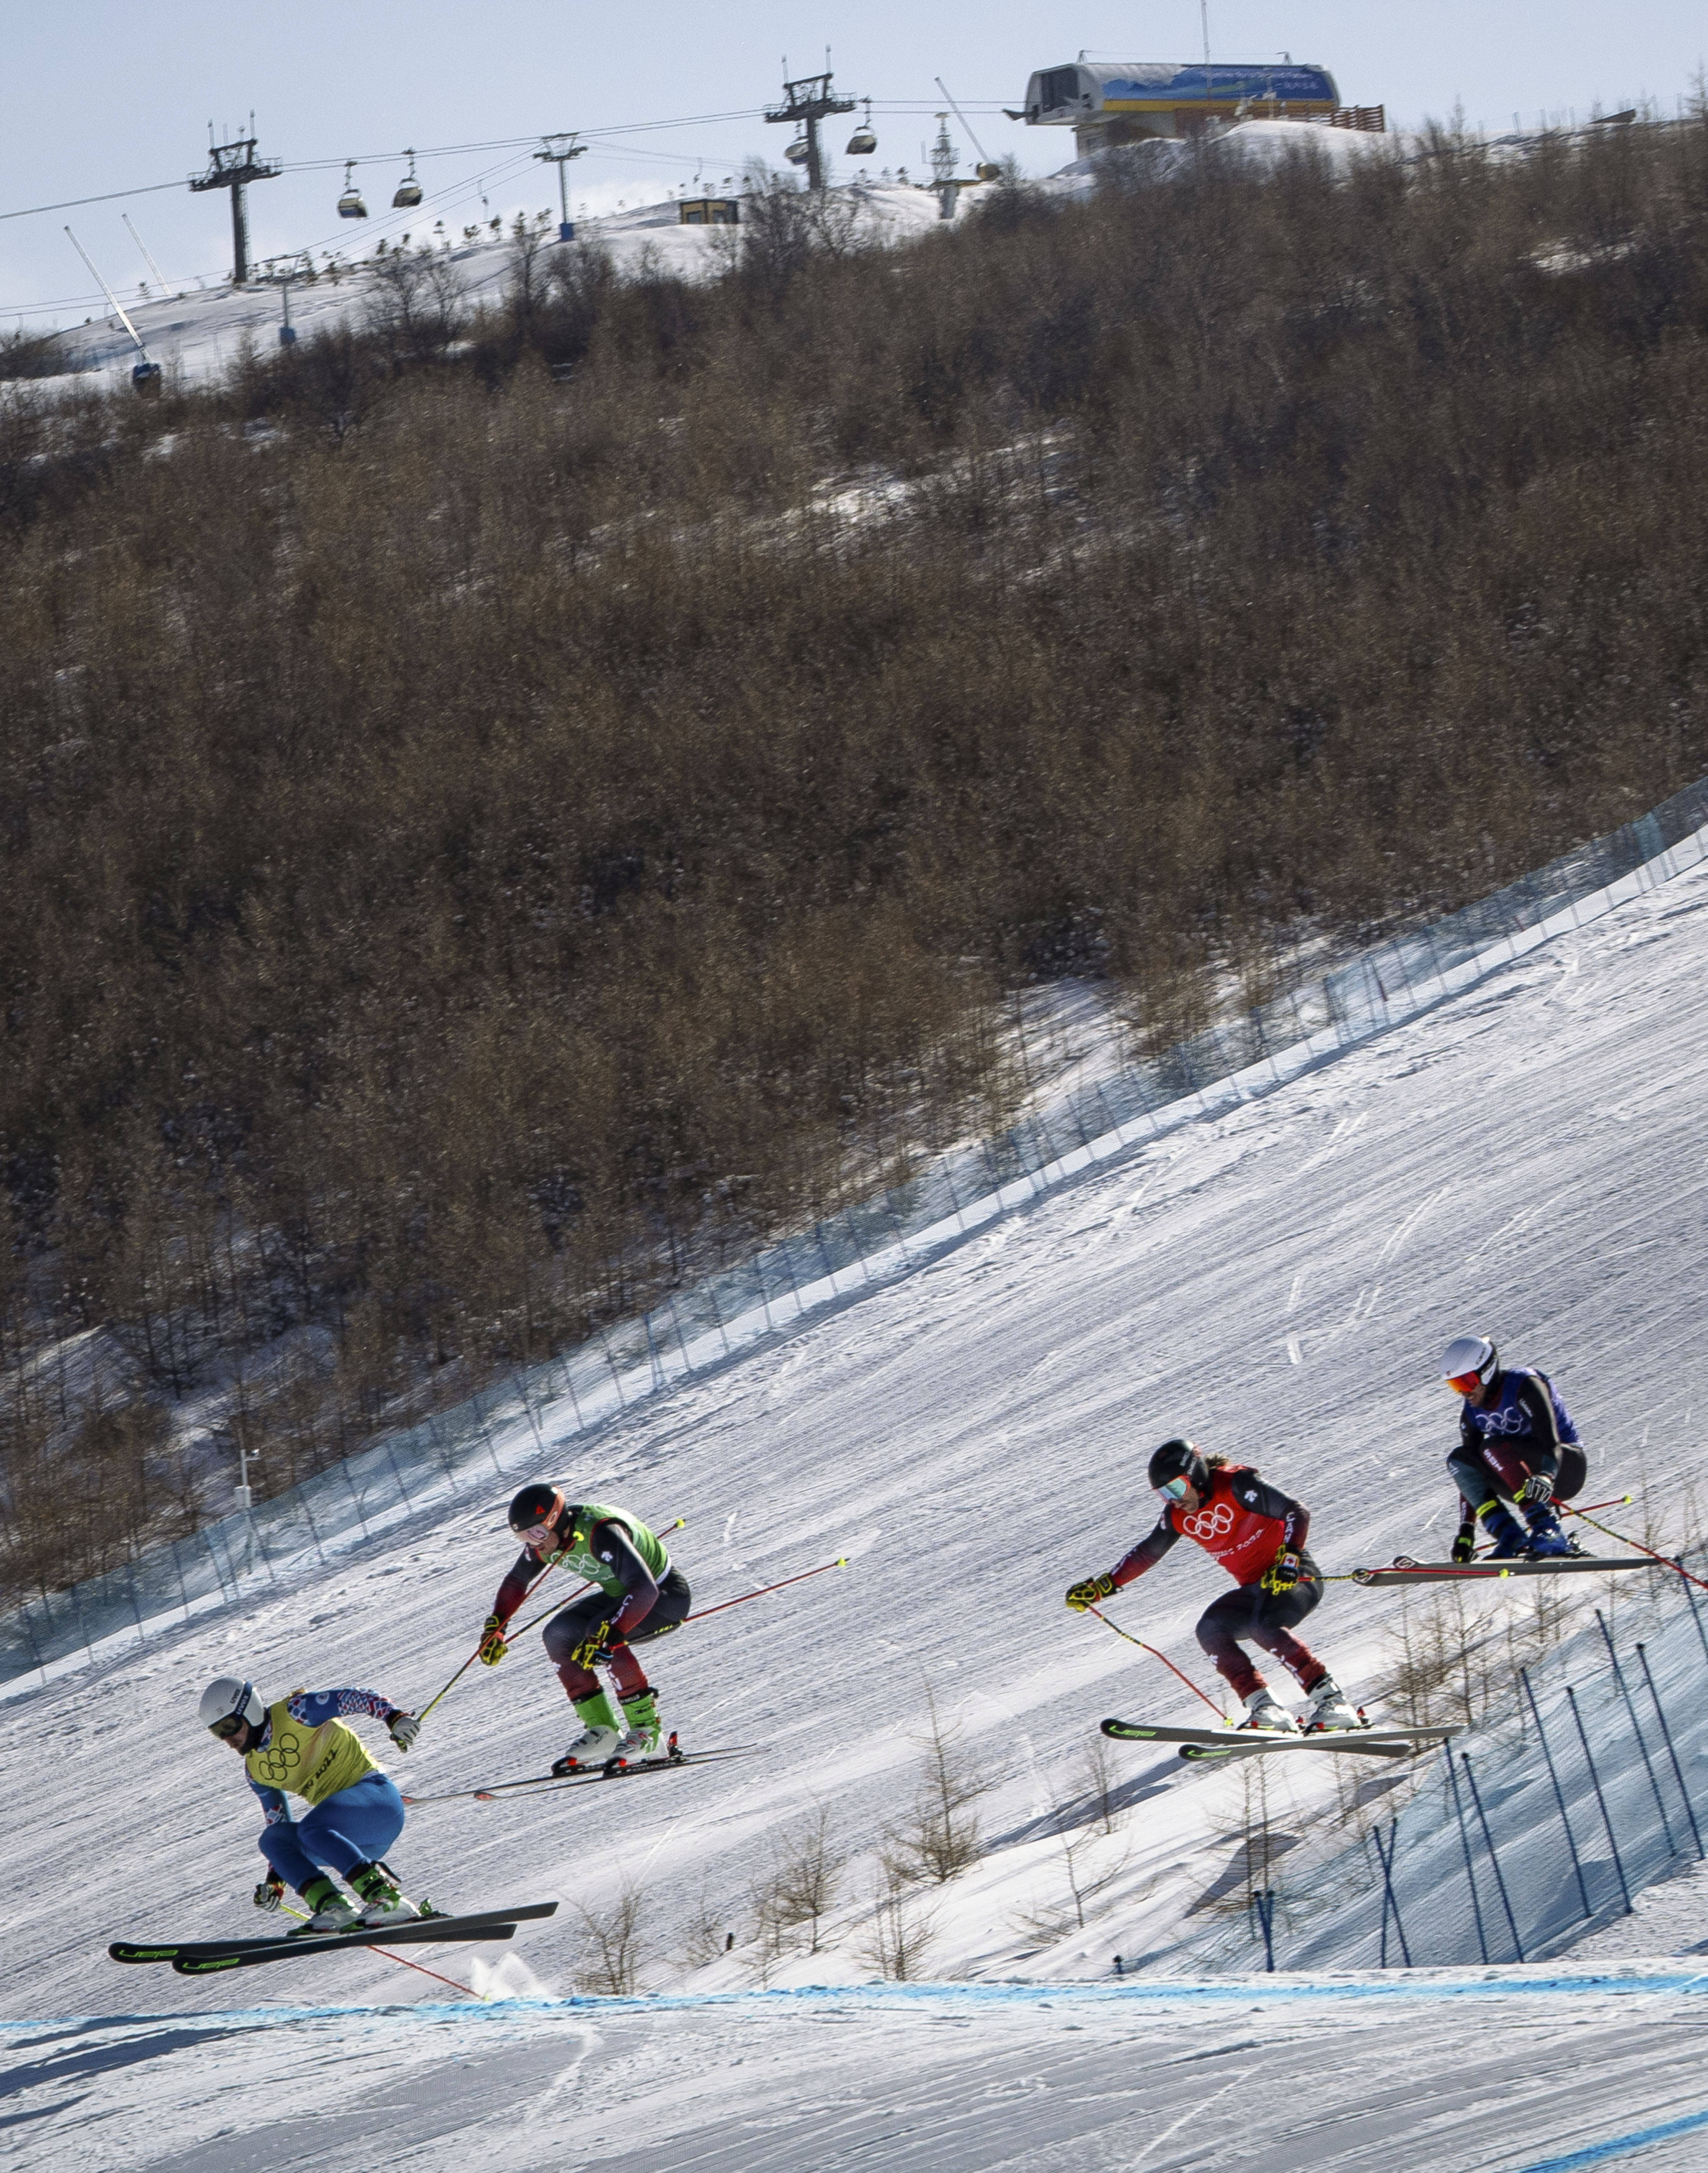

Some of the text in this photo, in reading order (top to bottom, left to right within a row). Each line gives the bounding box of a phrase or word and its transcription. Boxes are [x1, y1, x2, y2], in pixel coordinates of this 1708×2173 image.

[236, 1694, 249, 1715] uvex
[1109, 1725, 1156, 1738] elan
[119, 1949, 179, 1958] elan
[182, 1958, 240, 1969] elan
